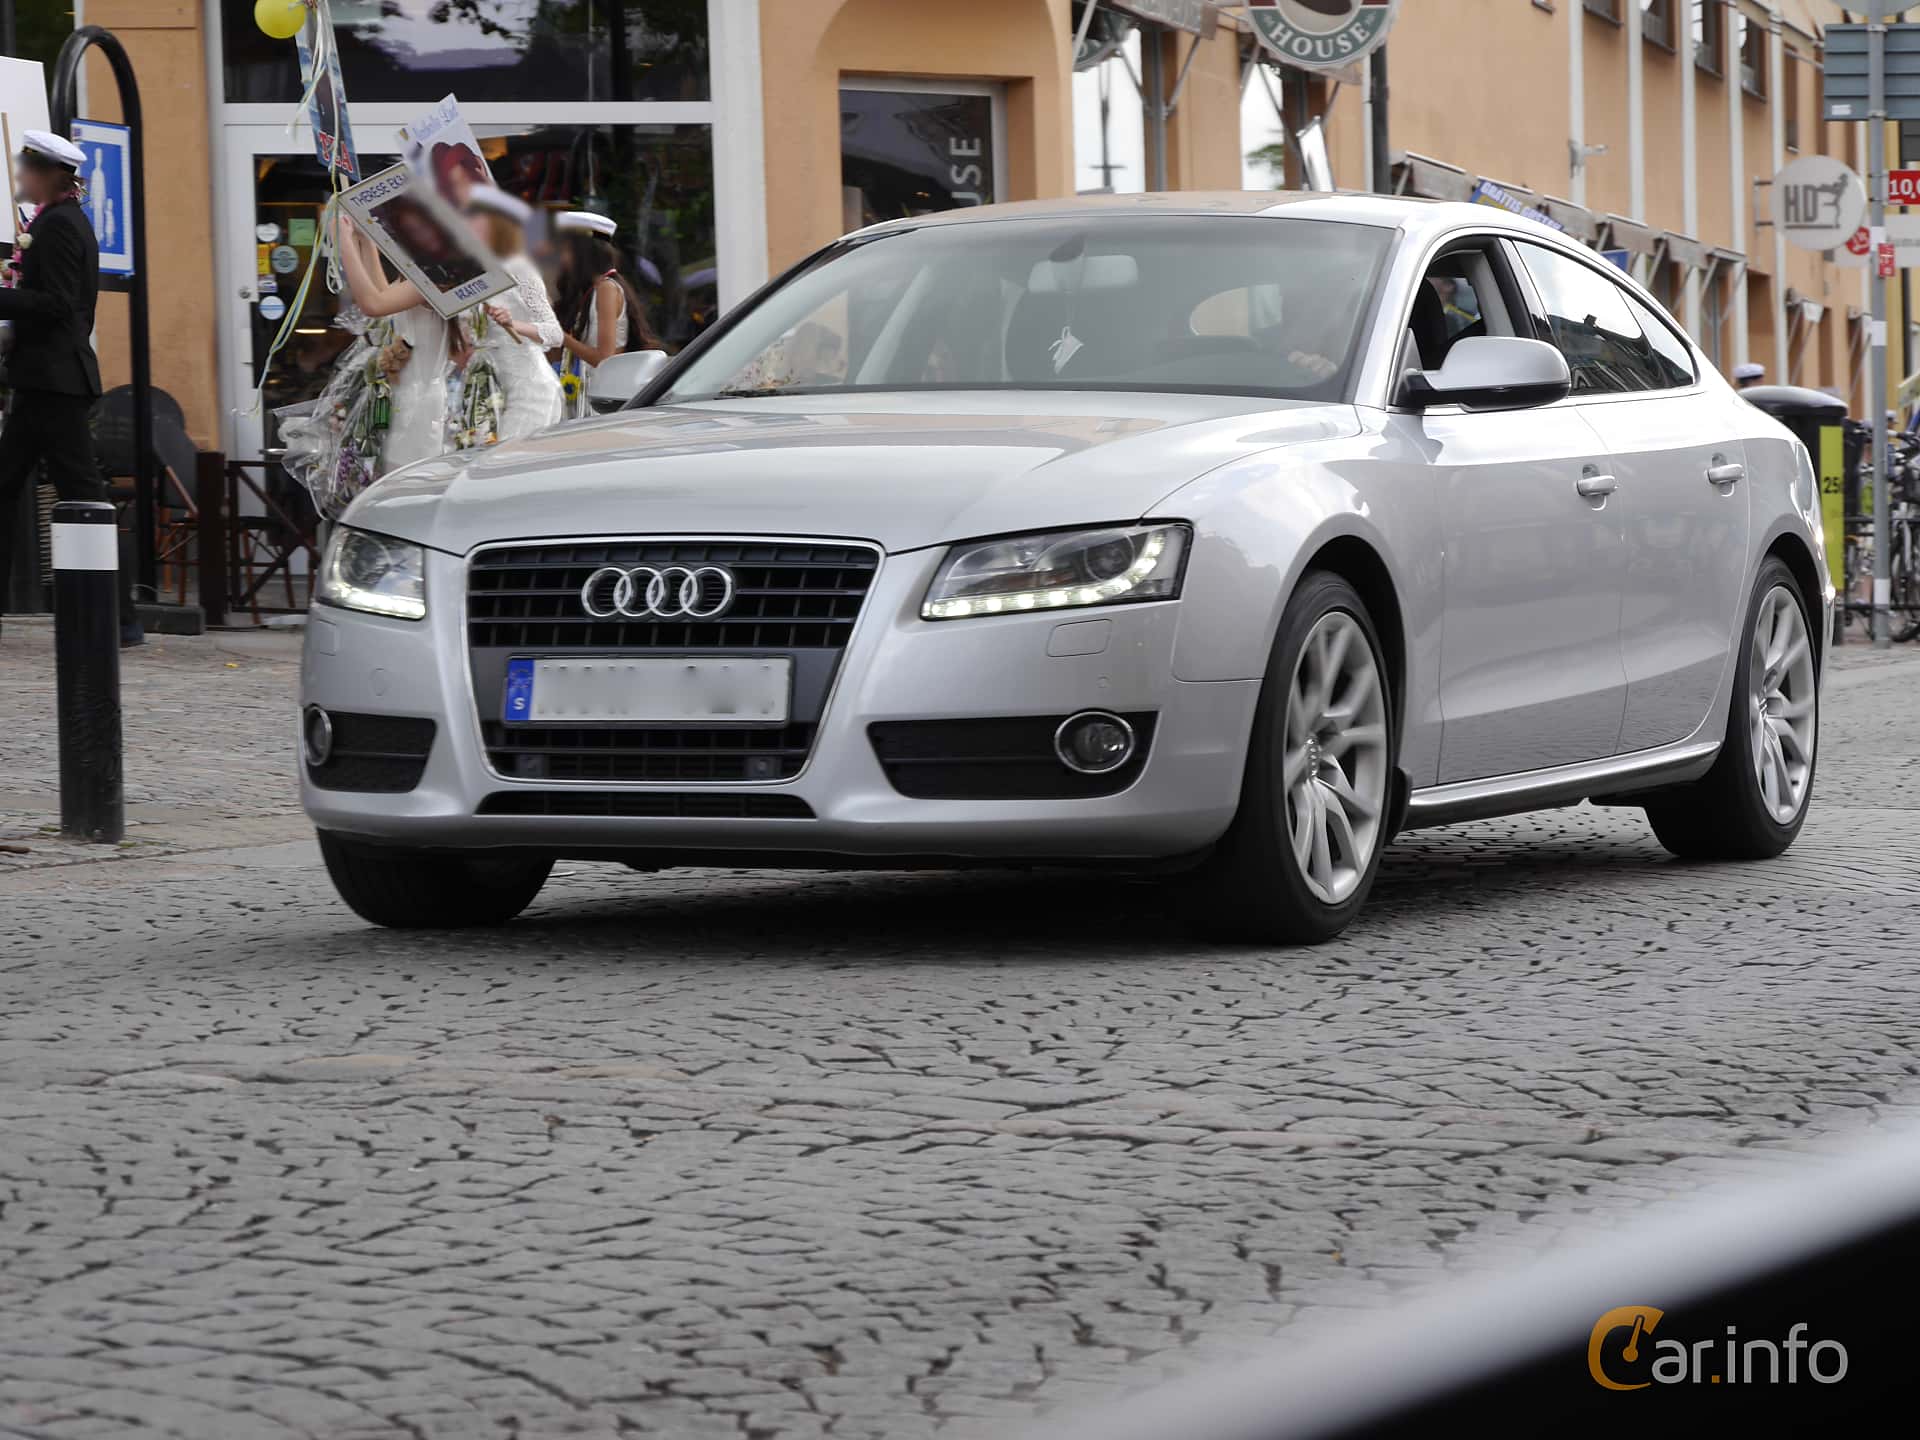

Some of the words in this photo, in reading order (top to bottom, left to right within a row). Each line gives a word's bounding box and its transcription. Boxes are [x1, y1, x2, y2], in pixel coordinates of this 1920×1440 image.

[1269, 21, 1371, 58] HOUSE
[1784, 184, 1818, 222] HD
[1823, 476, 1840, 493] 25
[513, 697, 525, 710] S
